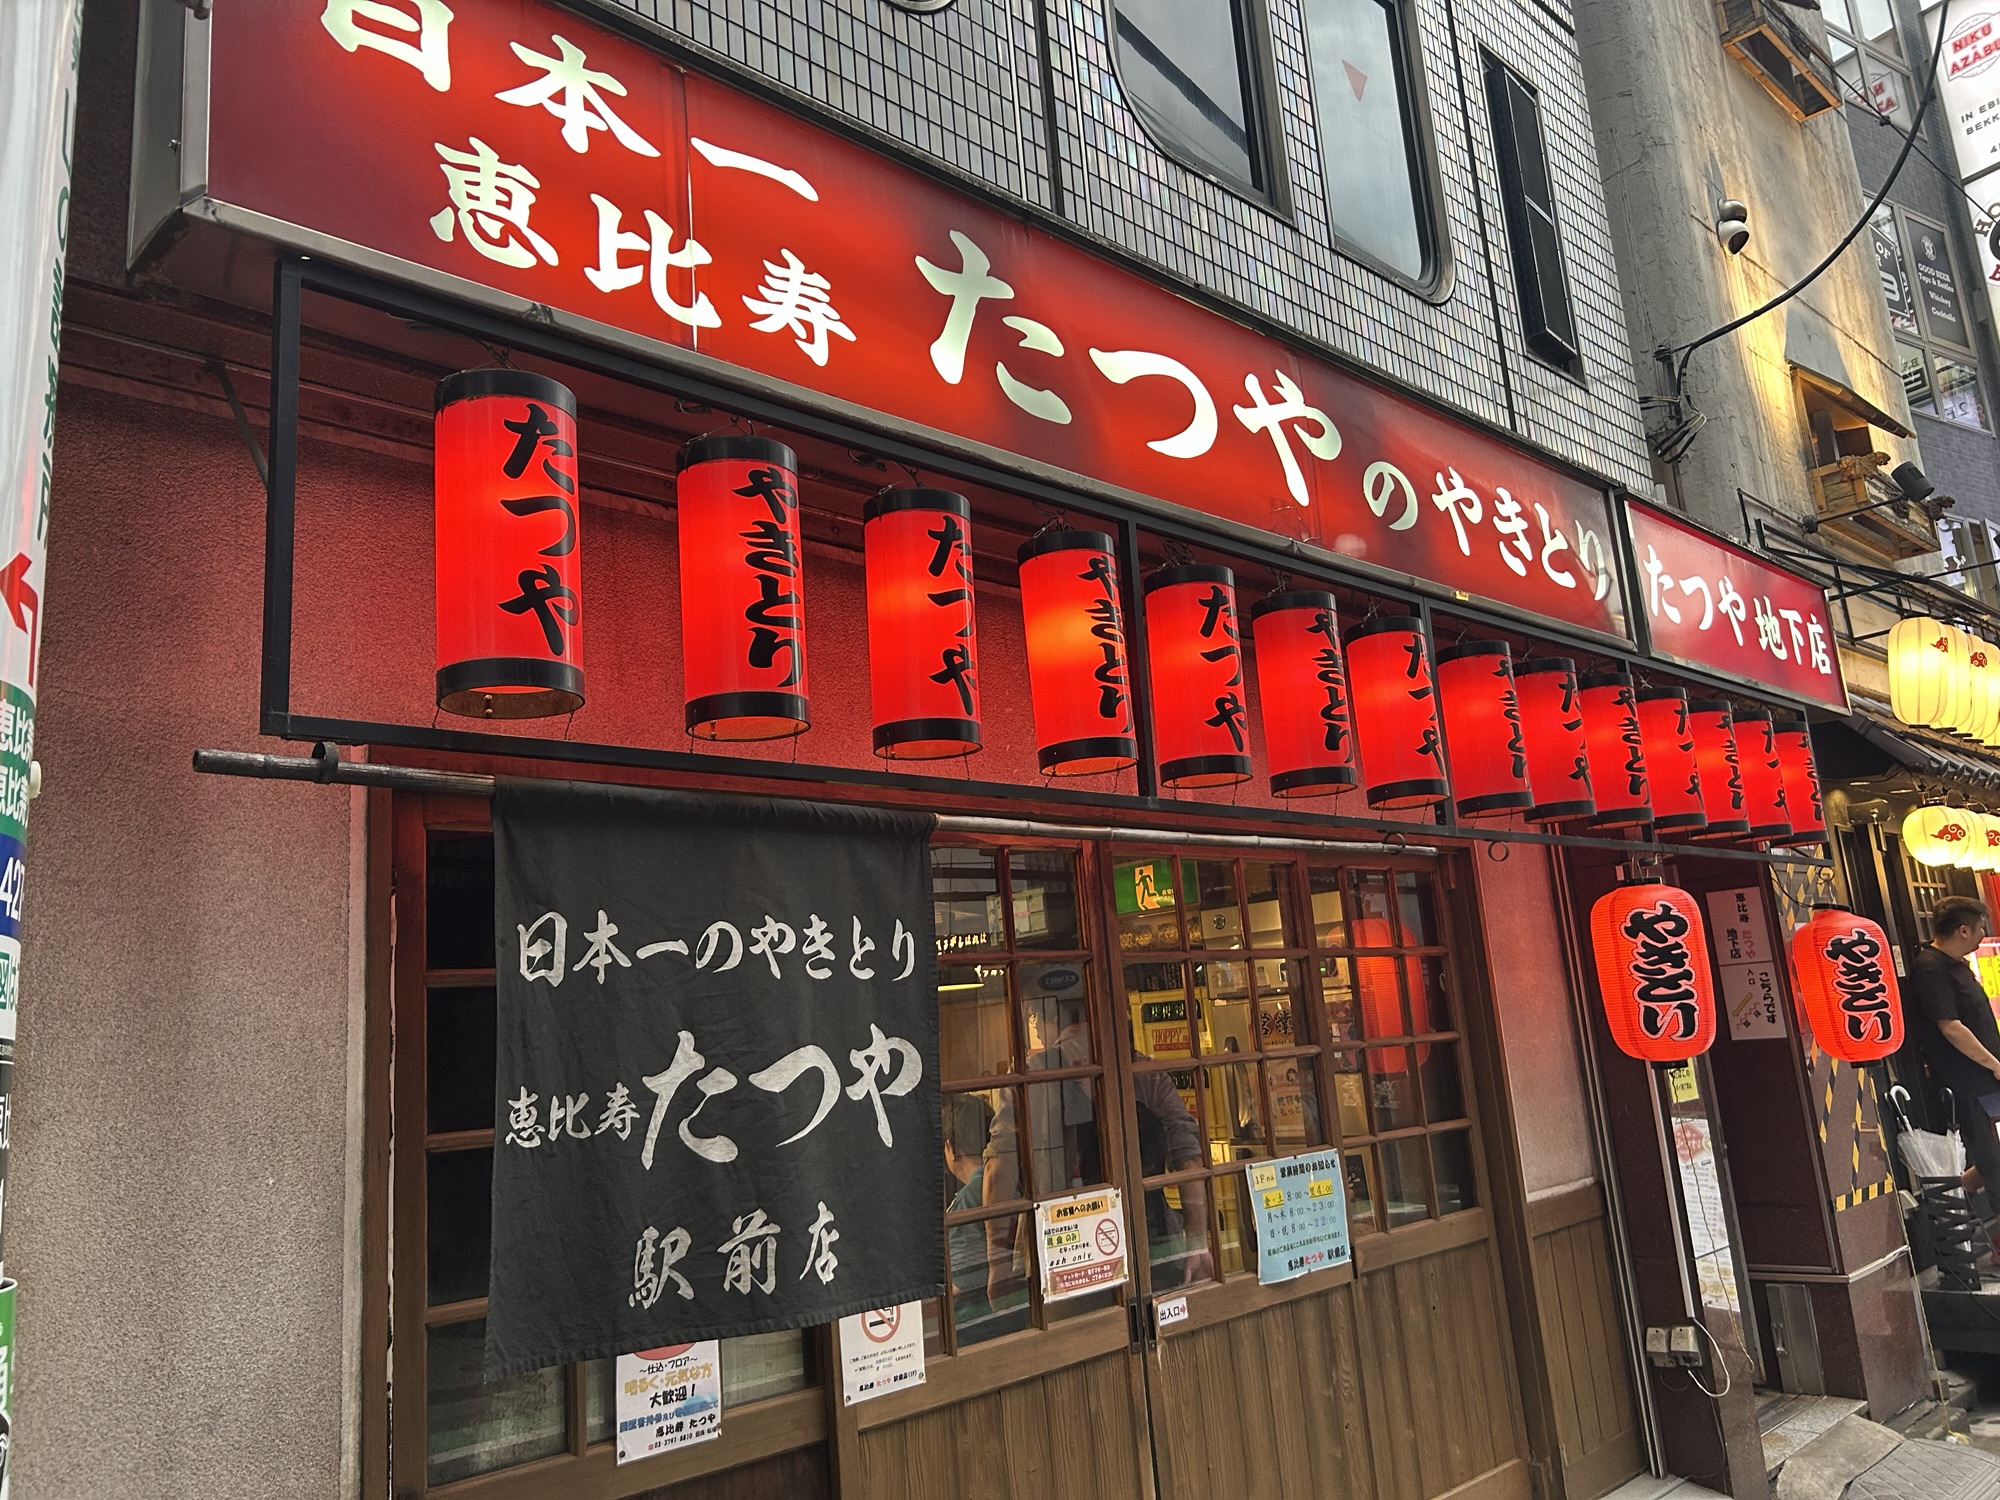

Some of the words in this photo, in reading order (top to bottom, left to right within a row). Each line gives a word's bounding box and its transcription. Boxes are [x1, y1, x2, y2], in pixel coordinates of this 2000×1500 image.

[1952, 22, 1992, 54] NIKU
[321, 0, 818, 201] 日本一
[1961, 111, 1974, 123] IN
[1917, 263, 1936, 278] GOOD
[1935, 270, 1951, 283] BEER
[429, 136, 856, 366] 恵比寿
[915, 229, 1342, 507] たつや
[497, 403, 580, 656] たつや
[732, 466, 804, 688] やきとり
[1643, 544, 1746, 647] たつや
[1753, 595, 1832, 675] 地下店
[927, 515, 977, 716] たつや
[1078, 556, 1133, 734] やきとり
[1197, 585, 1248, 753] たつや
[1304, 609, 1353, 764] やきとり
[1612, 687, 1650, 805] やきとり
[1735, 892, 1750, 923] 恵比寿
[516, 910, 916, 987] 日本一のやきとり
[1621, 902, 1699, 1040] やきとり
[1726, 928, 1742, 959] 地下店
[1741, 930, 1756, 959] たつや
[1759, 971, 1777, 1025] こちらです
[1824, 929, 1894, 1042] やきとり
[1155, 1029, 1182, 1044] HOPPY
[505, 1082, 641, 1148] 恵比寿
[641, 1023, 924, 1170] たつや
[1279, 1158, 1336, 1178] 営業時間のお知らせ
[1056, 1200, 1104, 1218] お客様へのお願い
[629, 1201, 841, 1310] 駅前店
[1047, 1256, 1067, 1267] ash
[1072, 1252, 1092, 1262] only
[1304, 1252, 1324, 1265] たつや
[1159, 1306, 1180, 1320] 出入口
[624, 1361, 713, 1396] 明るく・元気な方
[655, 1420, 684, 1438] 恵比寿
[689, 1413, 716, 1429] たつや
